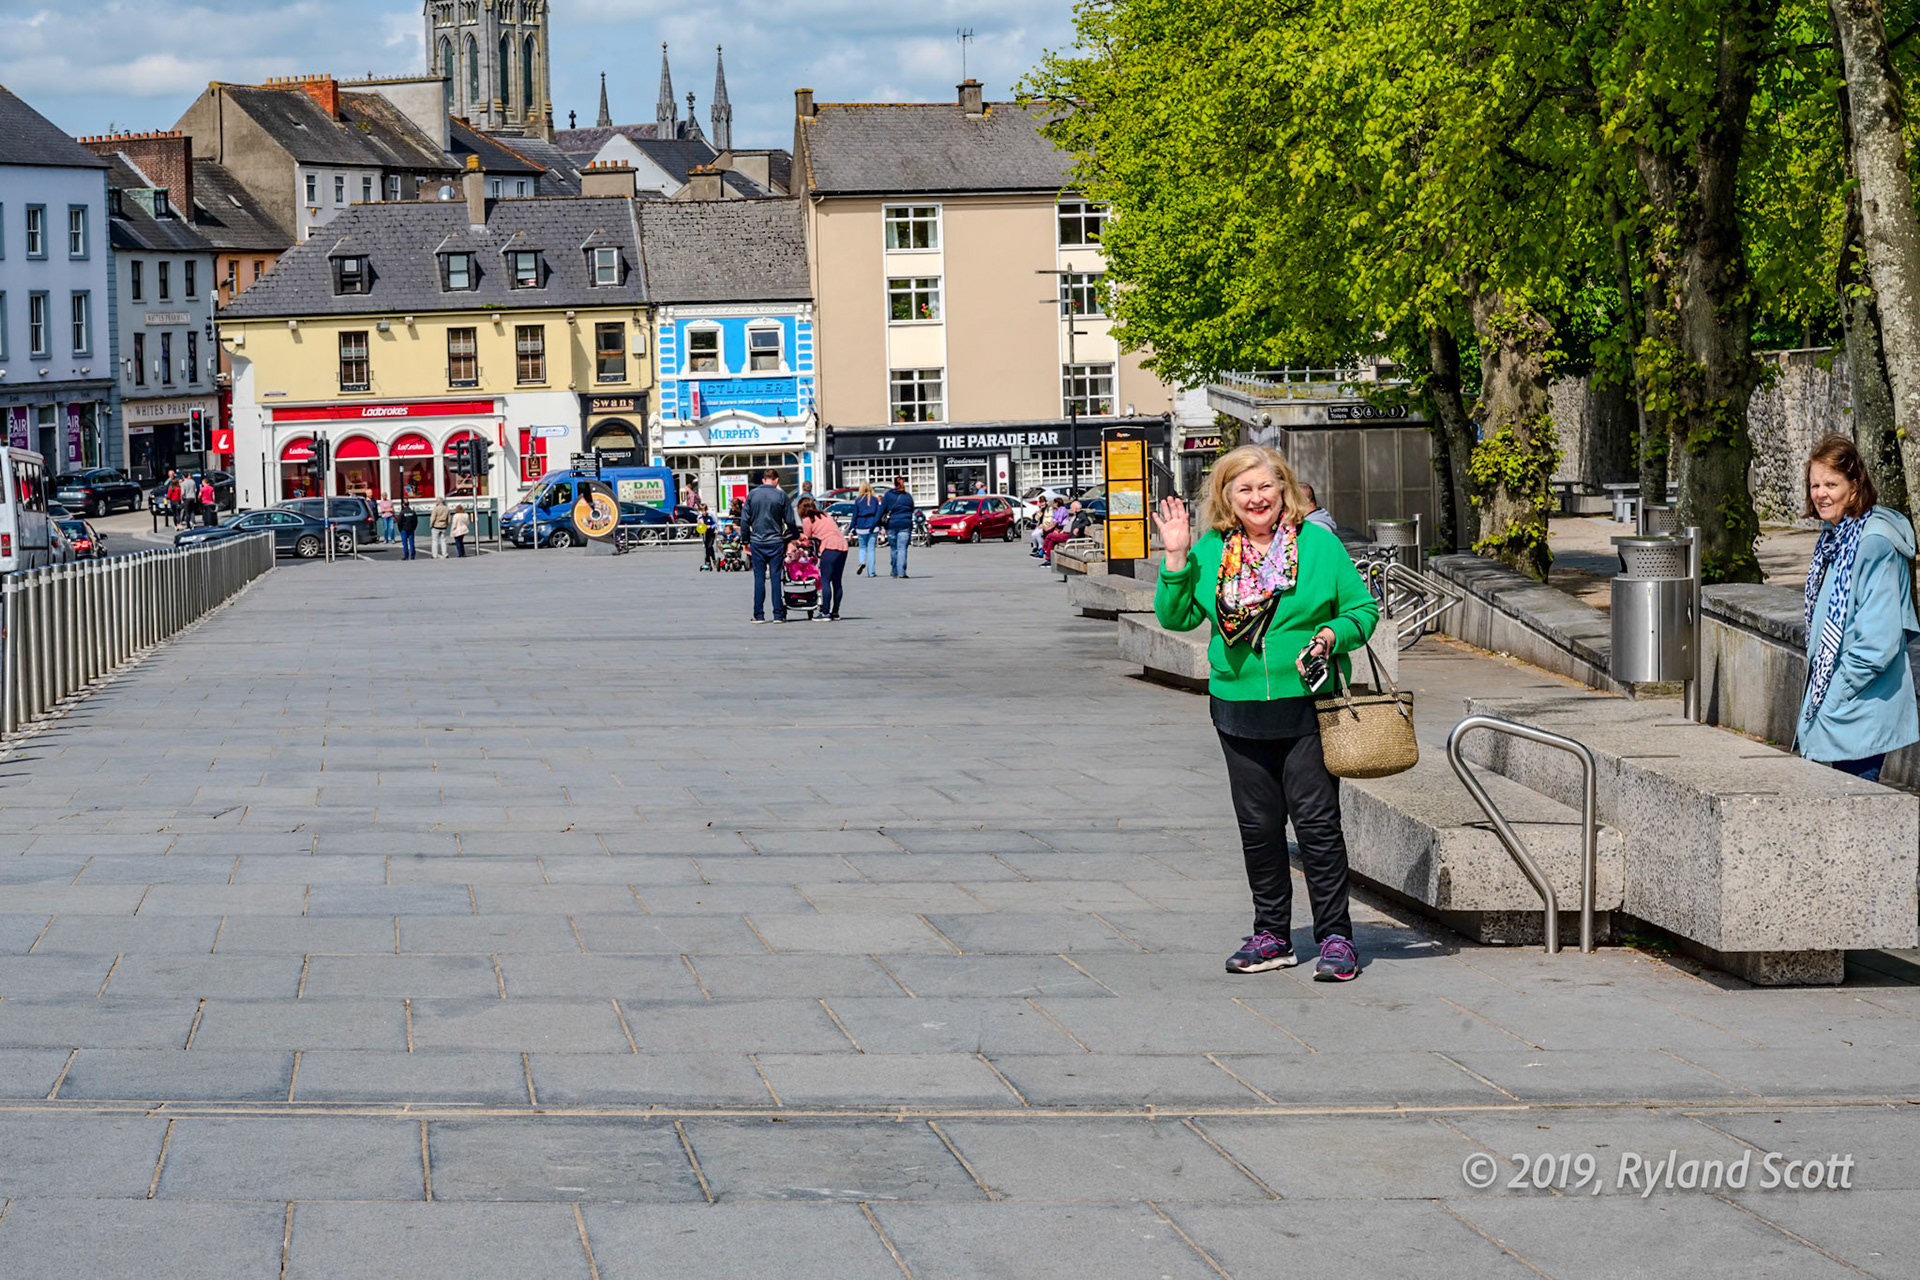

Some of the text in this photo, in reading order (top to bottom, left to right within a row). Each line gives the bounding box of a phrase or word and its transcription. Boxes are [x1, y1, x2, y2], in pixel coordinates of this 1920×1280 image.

[592, 399, 635, 408] Swans
[135, 404, 164, 416] WHITES
[361, 407, 408, 417] Ladbrokes
[10, 419, 27, 432] FAIR
[877, 438, 896, 451] 17
[937, 432, 1059, 449] THE PARADE BAR
